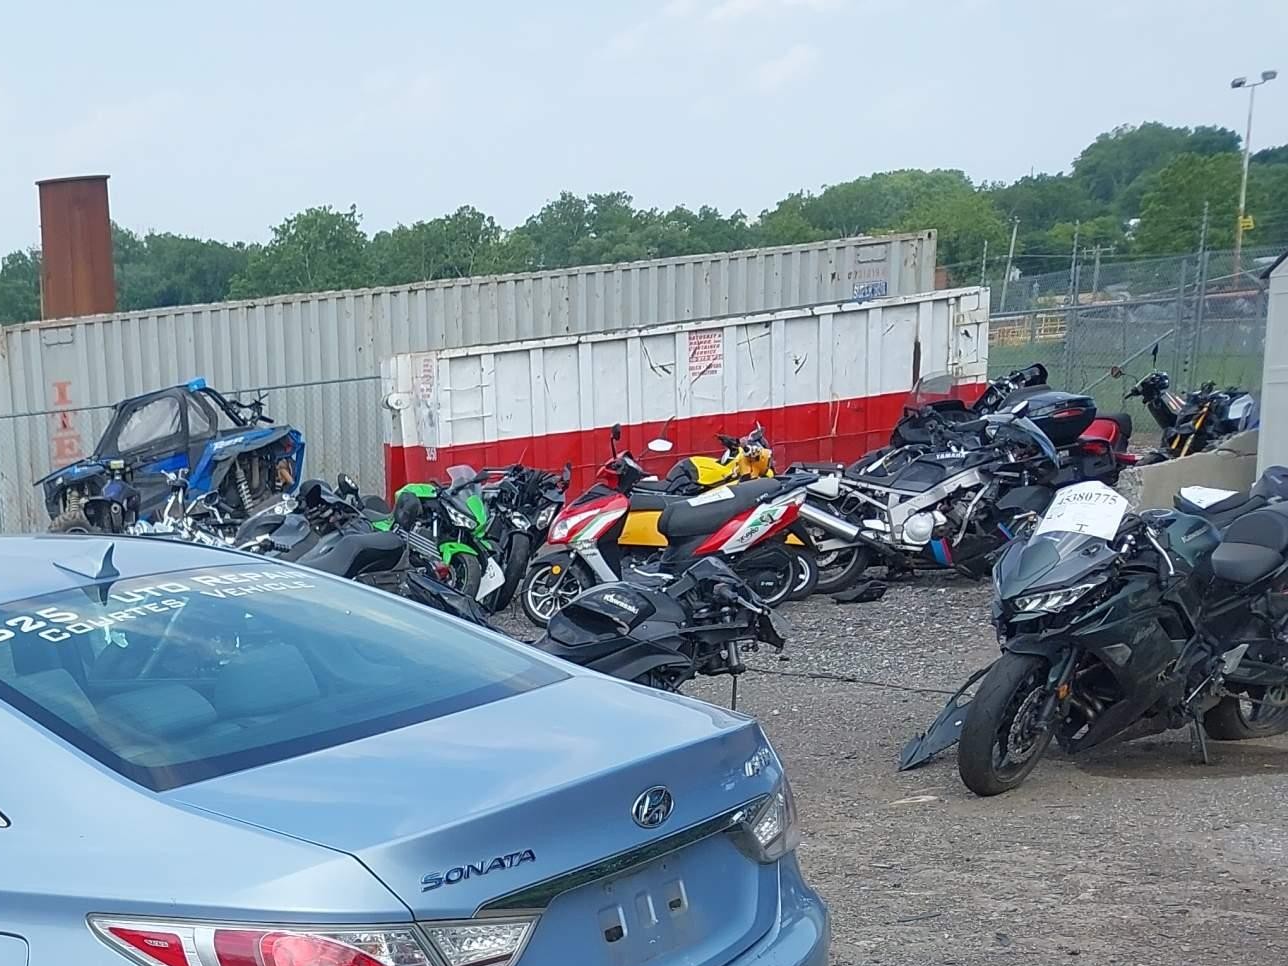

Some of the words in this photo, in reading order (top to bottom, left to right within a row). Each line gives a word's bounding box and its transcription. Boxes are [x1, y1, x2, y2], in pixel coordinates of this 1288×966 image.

[199, 581, 316, 599] VEHICLE
[603, 593, 639, 614] Kawasaki
[420, 850, 537, 893] SONATA
